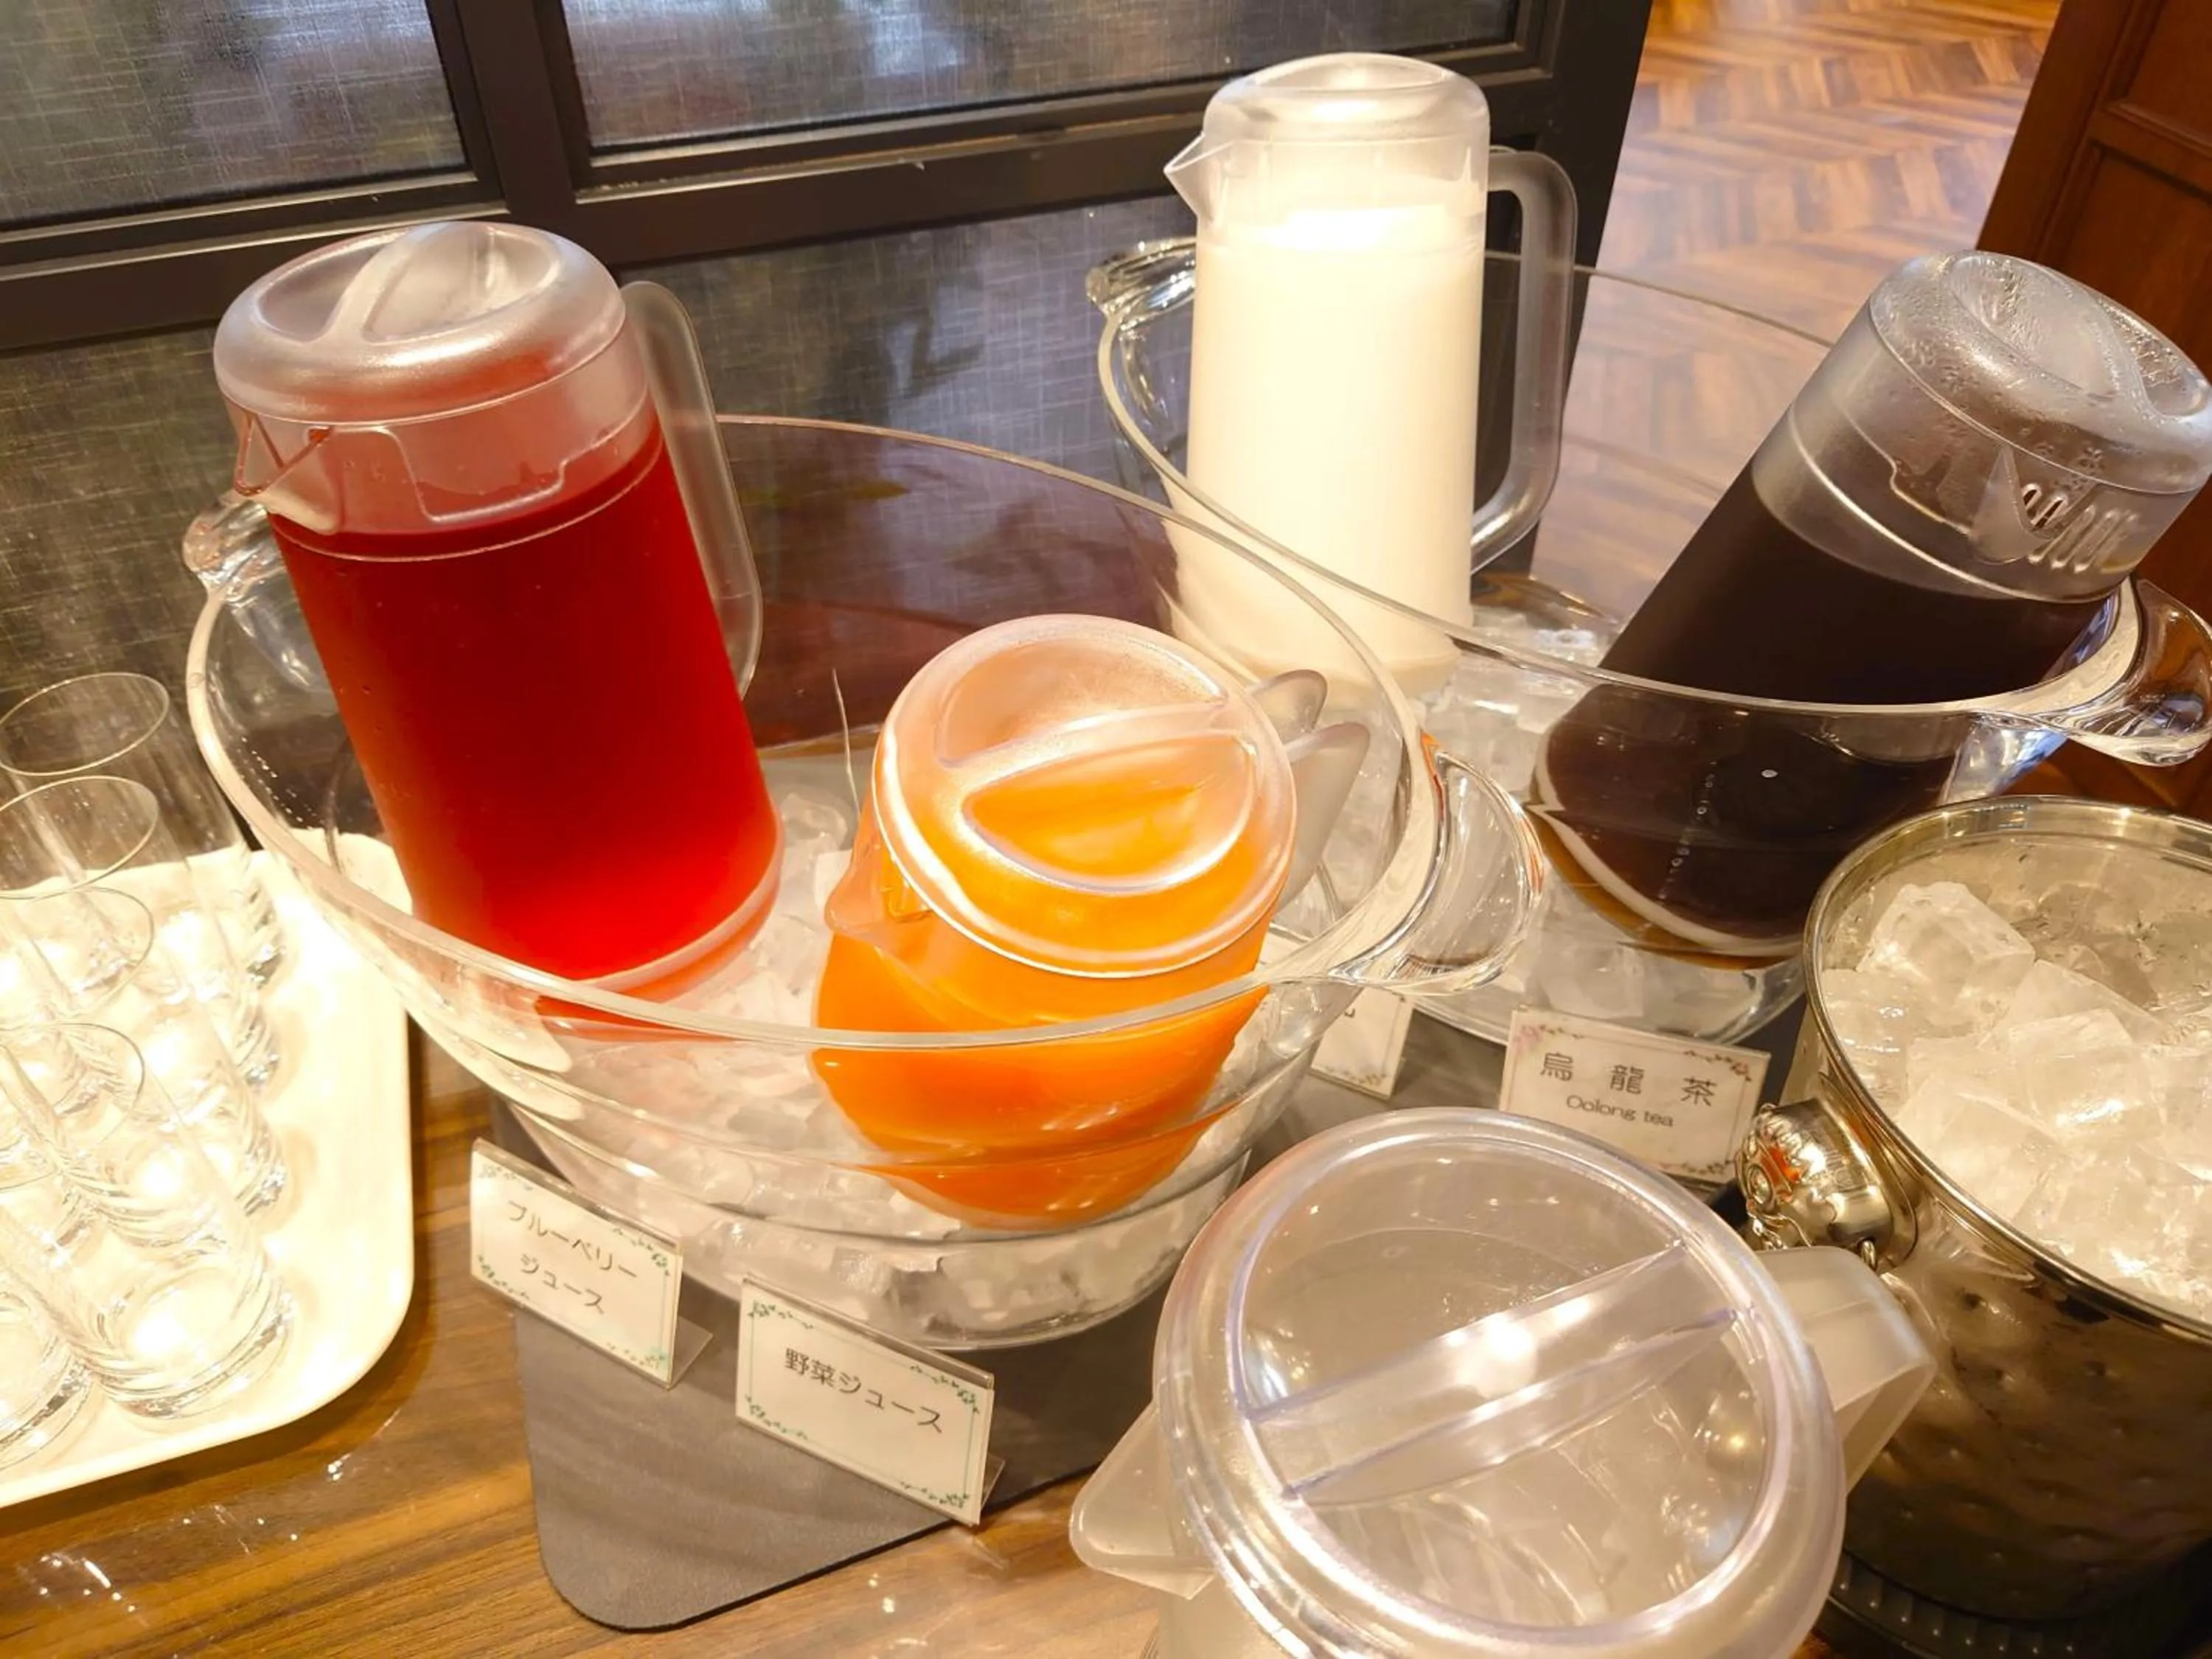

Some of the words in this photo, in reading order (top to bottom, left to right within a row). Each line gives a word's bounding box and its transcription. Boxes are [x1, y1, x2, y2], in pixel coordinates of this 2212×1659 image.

[1566, 1094, 1637, 1121] Oolong
[1643, 1110, 1674, 1127] tea
[521, 1253, 605, 1315] ジュース
[784, 1347, 943, 1434] 野菜ジュース
